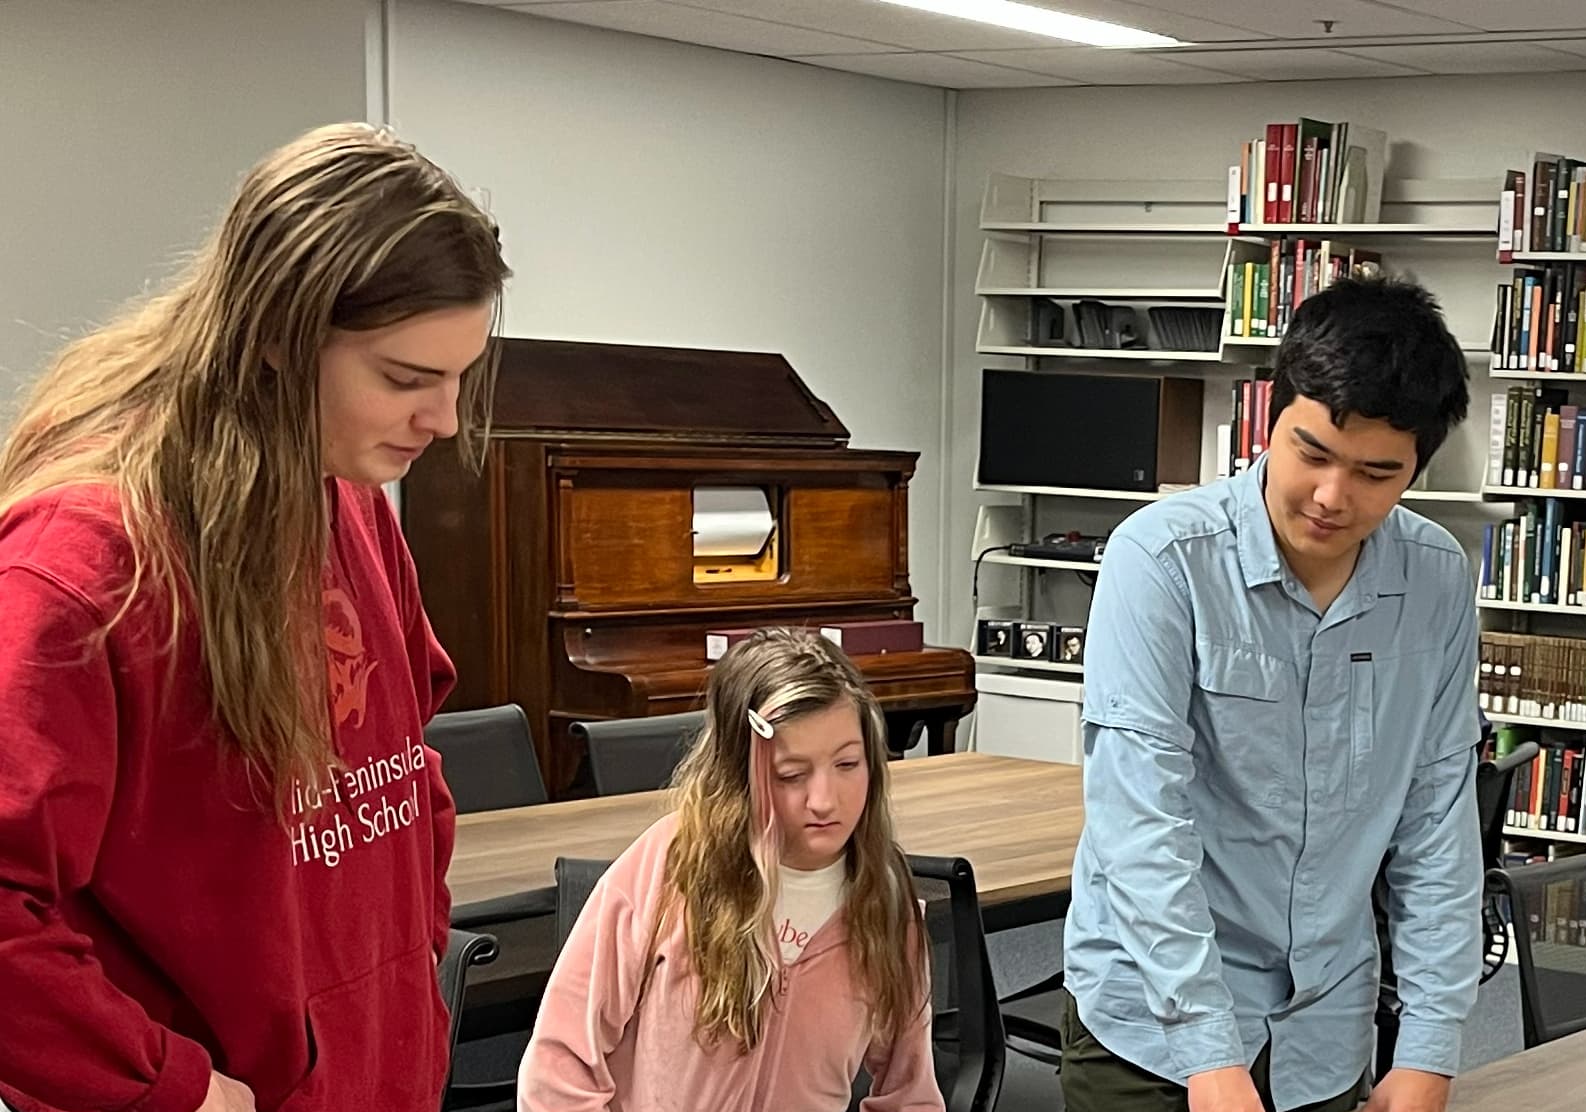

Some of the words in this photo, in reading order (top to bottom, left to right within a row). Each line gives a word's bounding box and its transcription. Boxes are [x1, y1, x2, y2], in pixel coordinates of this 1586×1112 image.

[291, 813, 354, 867] High
[357, 780, 420, 843] Schol
[776, 918, 809, 948] be
